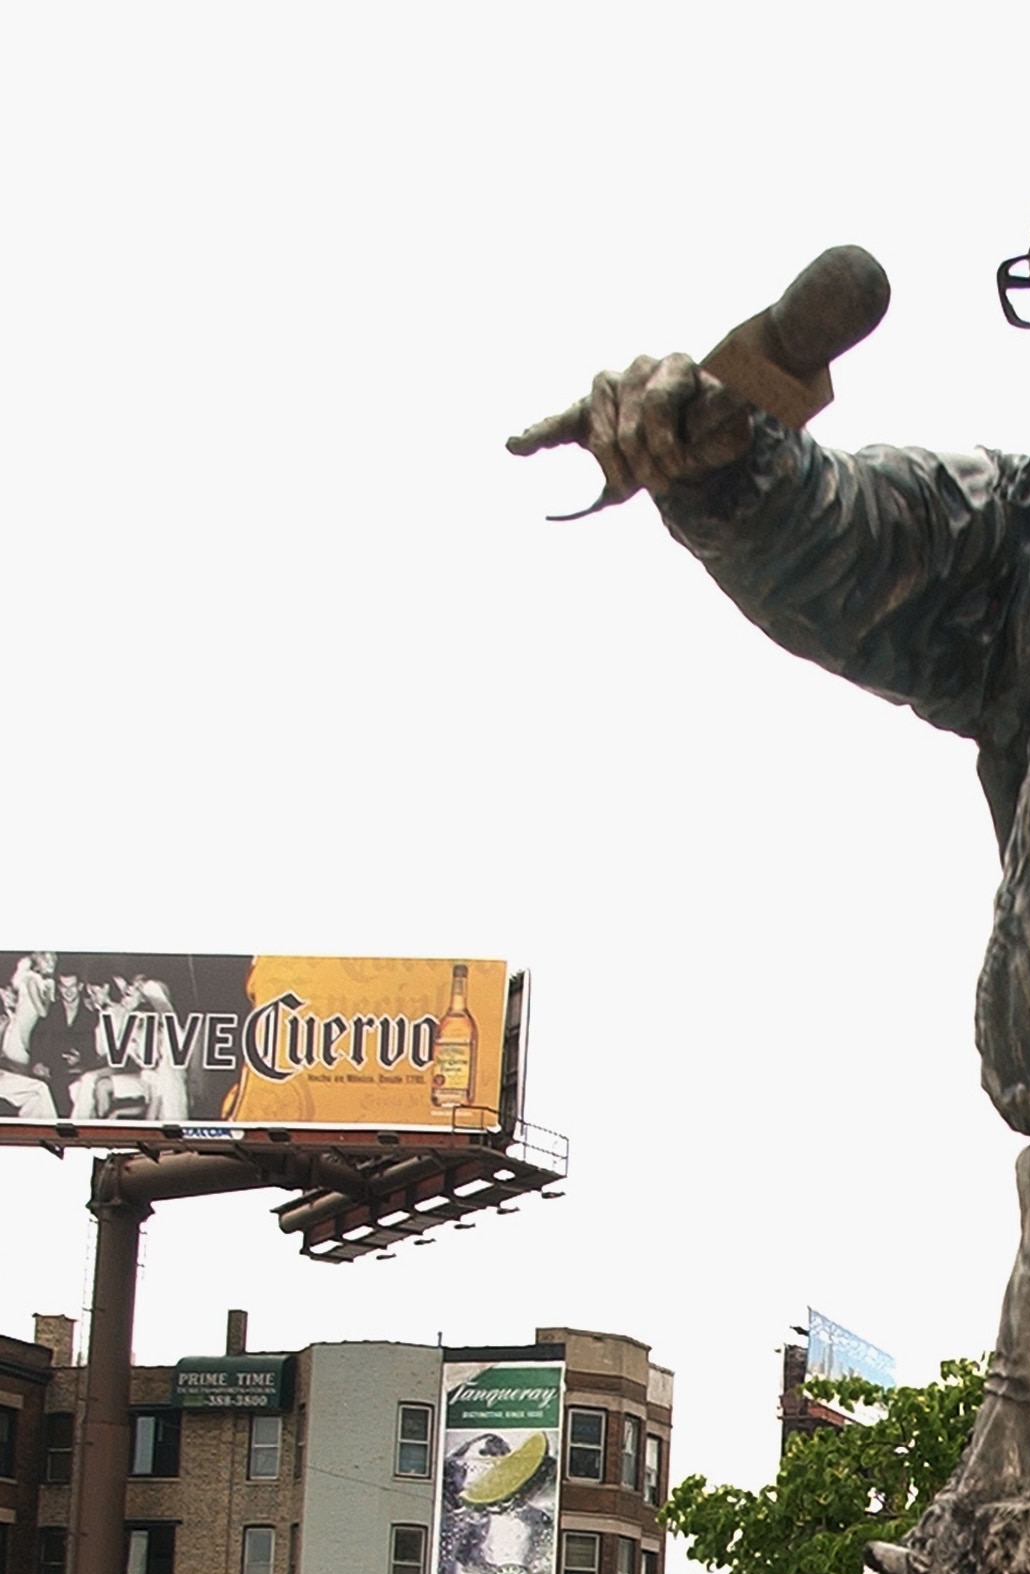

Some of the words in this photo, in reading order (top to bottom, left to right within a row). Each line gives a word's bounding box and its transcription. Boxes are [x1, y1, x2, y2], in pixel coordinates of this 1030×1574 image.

[102, 1012, 238, 1070] VIVE
[244, 990, 439, 1080] Cuervo
[178, 1372, 227, 1386] PRIME
[236, 1372, 276, 1386] TIME
[448, 1381, 557, 1409] Tanqueray
